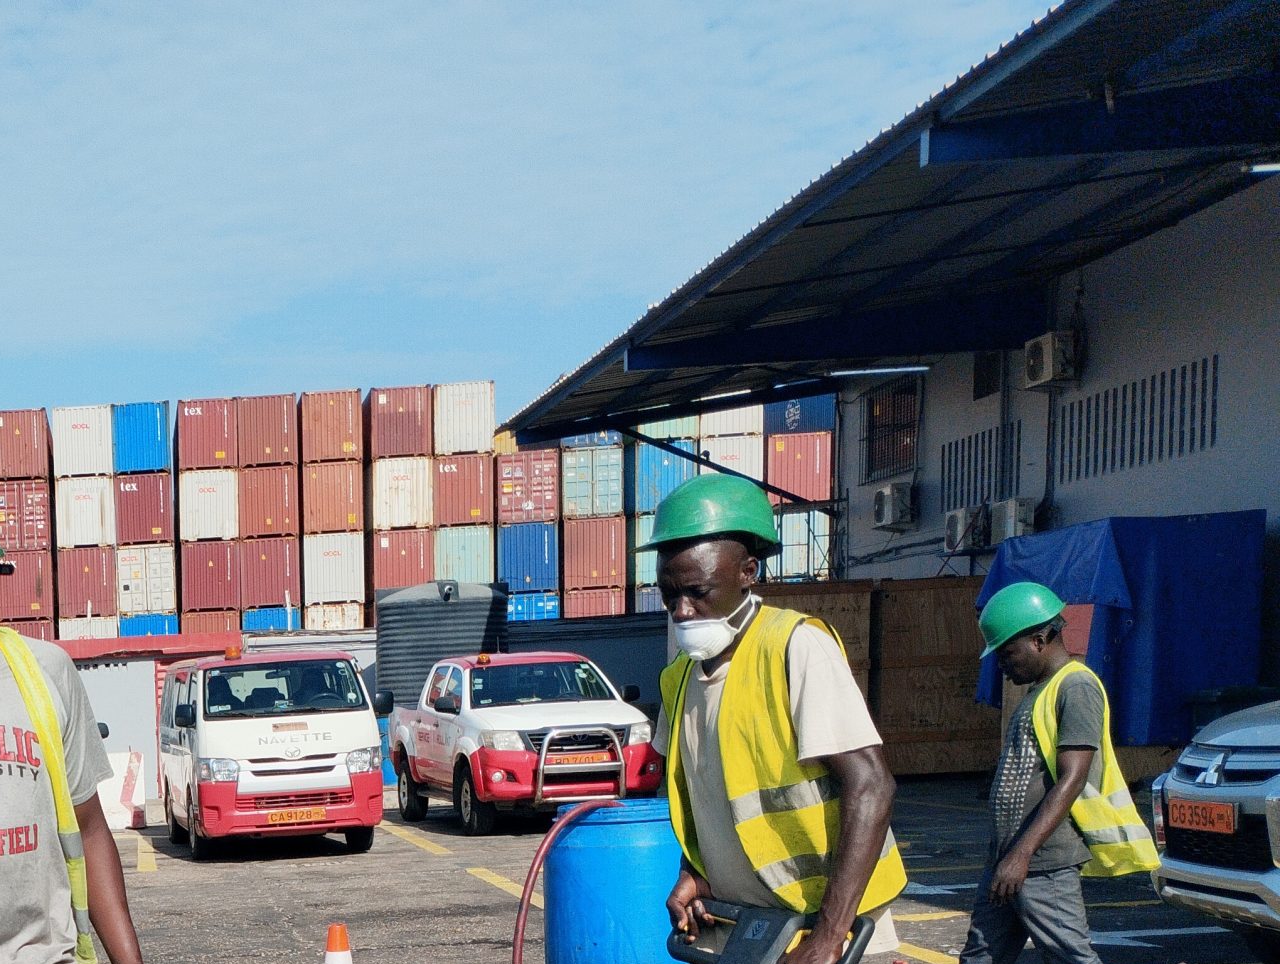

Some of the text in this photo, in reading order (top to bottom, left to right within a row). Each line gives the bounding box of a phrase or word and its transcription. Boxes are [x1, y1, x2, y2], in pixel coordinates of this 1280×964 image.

[184, 407, 202, 416] tex
[439, 463, 457, 473] tex
[120, 482, 138, 491] tex
[258, 732, 333, 745] NAVETTE
[271, 810, 312, 822] CA 9128
[1171, 804, 1187, 824] CG
